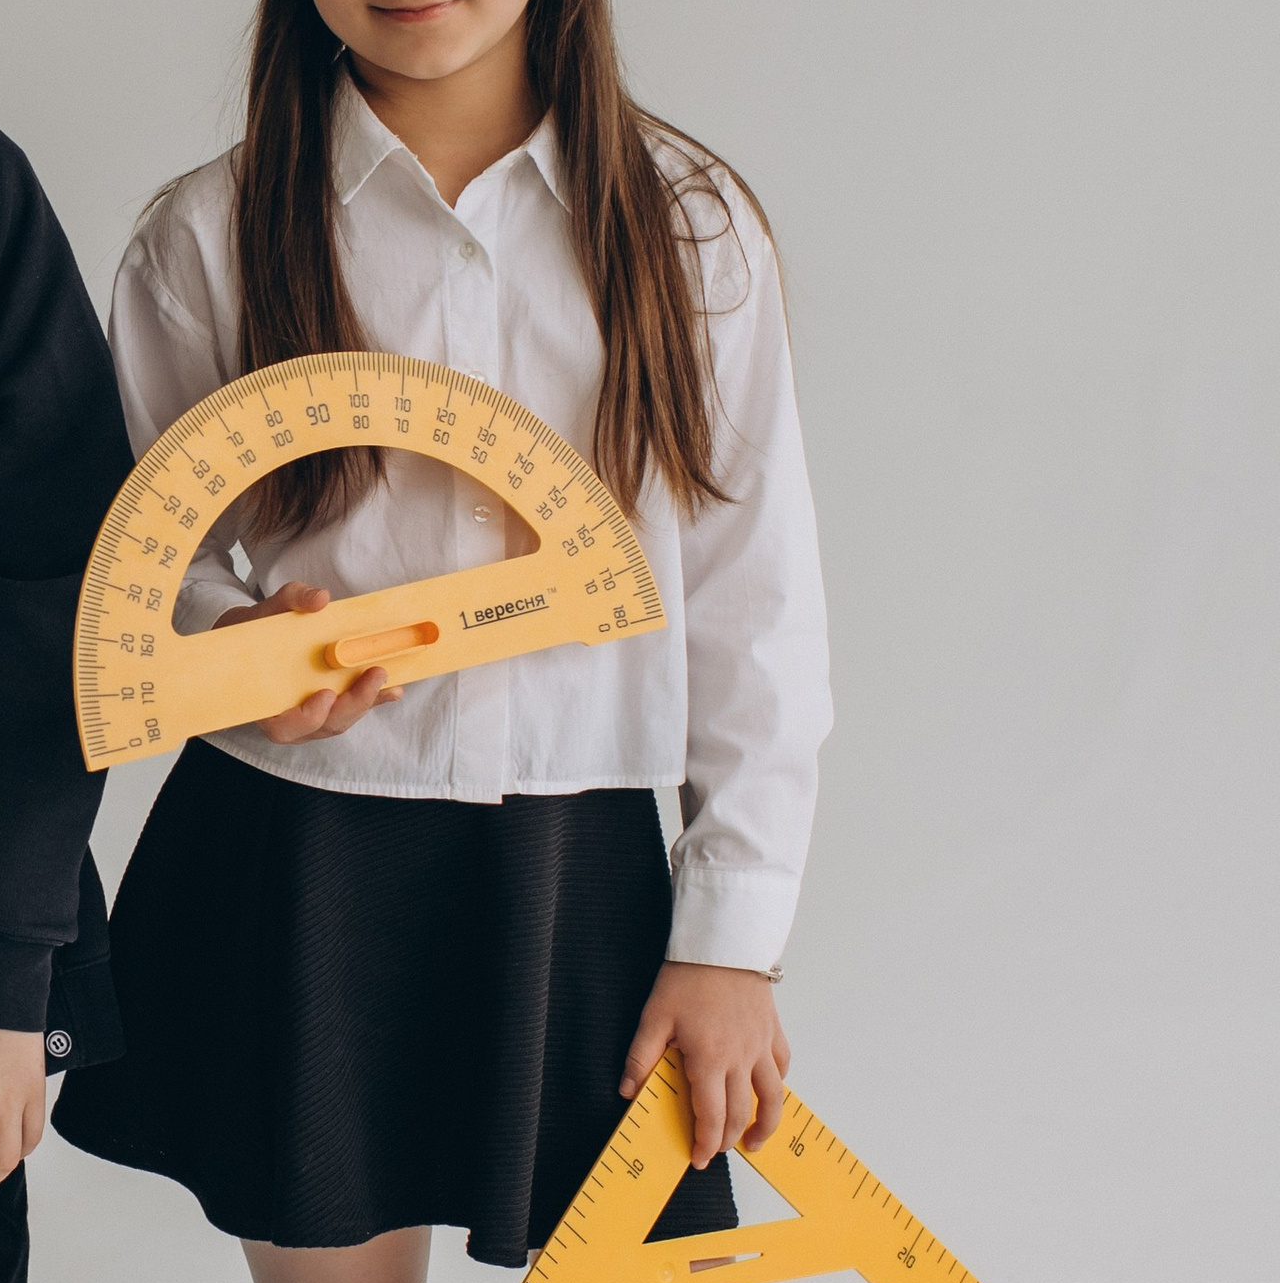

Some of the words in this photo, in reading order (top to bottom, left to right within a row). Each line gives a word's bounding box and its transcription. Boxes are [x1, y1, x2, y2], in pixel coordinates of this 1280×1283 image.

[348, 393, 370, 409] 100
[394, 396, 412, 413] 110
[264, 409, 284, 428] 80
[305, 403, 331, 426] 90
[352, 414, 370, 430] 80
[394, 417, 410, 434] 70
[436, 407, 457, 427] 120
[225, 430, 245, 448] 70
[270, 429, 294, 449] 100
[432, 428, 451, 446] 60
[476, 425, 497, 447] 130
[236, 448, 257, 468] 110
[470, 445, 488, 465] 50
[513, 452, 535, 476] 140
[192, 459, 211, 480] 60
[507, 469, 523, 490] 40
[204, 473, 227, 497] 120
[162, 494, 182, 516] 50
[547, 484, 568, 509] 150
[178, 506, 199, 530] 130
[535, 501, 554, 521] 30
[141, 536, 159, 555] 40
[561, 537, 580, 557] 20
[576, 523, 596, 549] 160
[158, 544, 178, 569] 140
[584, 578, 599, 595] 10
[598, 566, 617, 592] 170
[126, 583, 143, 604] 30
[145, 587, 163, 612] 150
[458, 610, 470, 630] 1
[474, 592, 546, 623] вересня
[612, 604, 629, 629] 180
[120, 632, 135, 654] 20
[139, 633, 156, 658] 160
[120, 686, 136, 702] 10
[140, 680, 155, 706] 170
[144, 717, 162, 744] 180
[788, 1135, 805, 1157] 10
[626, 1158, 644, 1180] 10
[897, 1246, 916, 1269] 20
